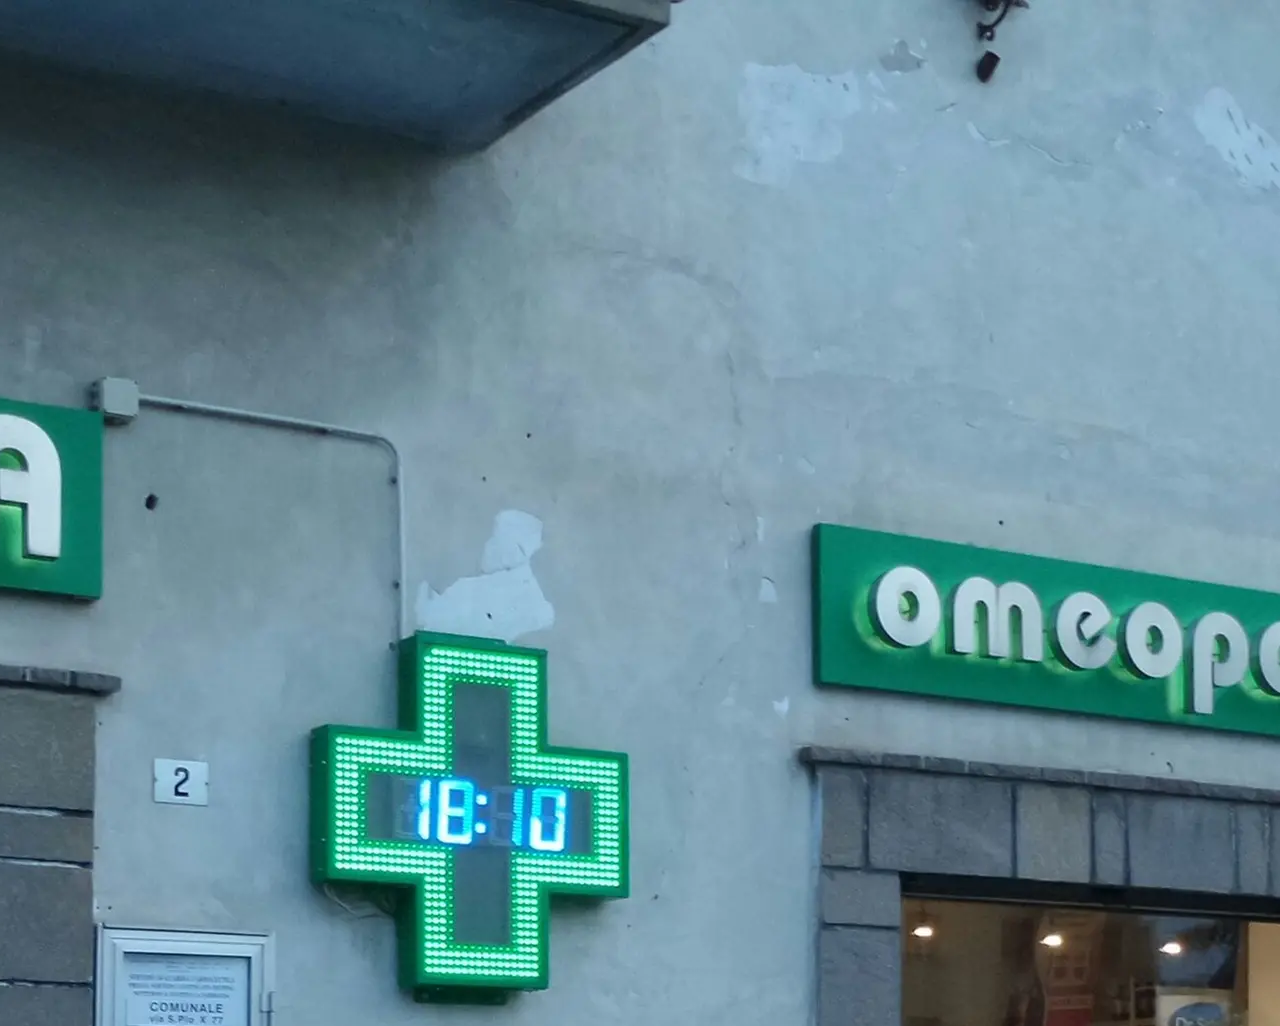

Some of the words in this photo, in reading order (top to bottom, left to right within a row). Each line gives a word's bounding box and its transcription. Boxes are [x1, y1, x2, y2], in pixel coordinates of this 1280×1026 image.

[173, 766, 190, 798] 2
[417, 778, 567, 852] 18:10
[149, 1001, 224, 1014] COMUNALE
